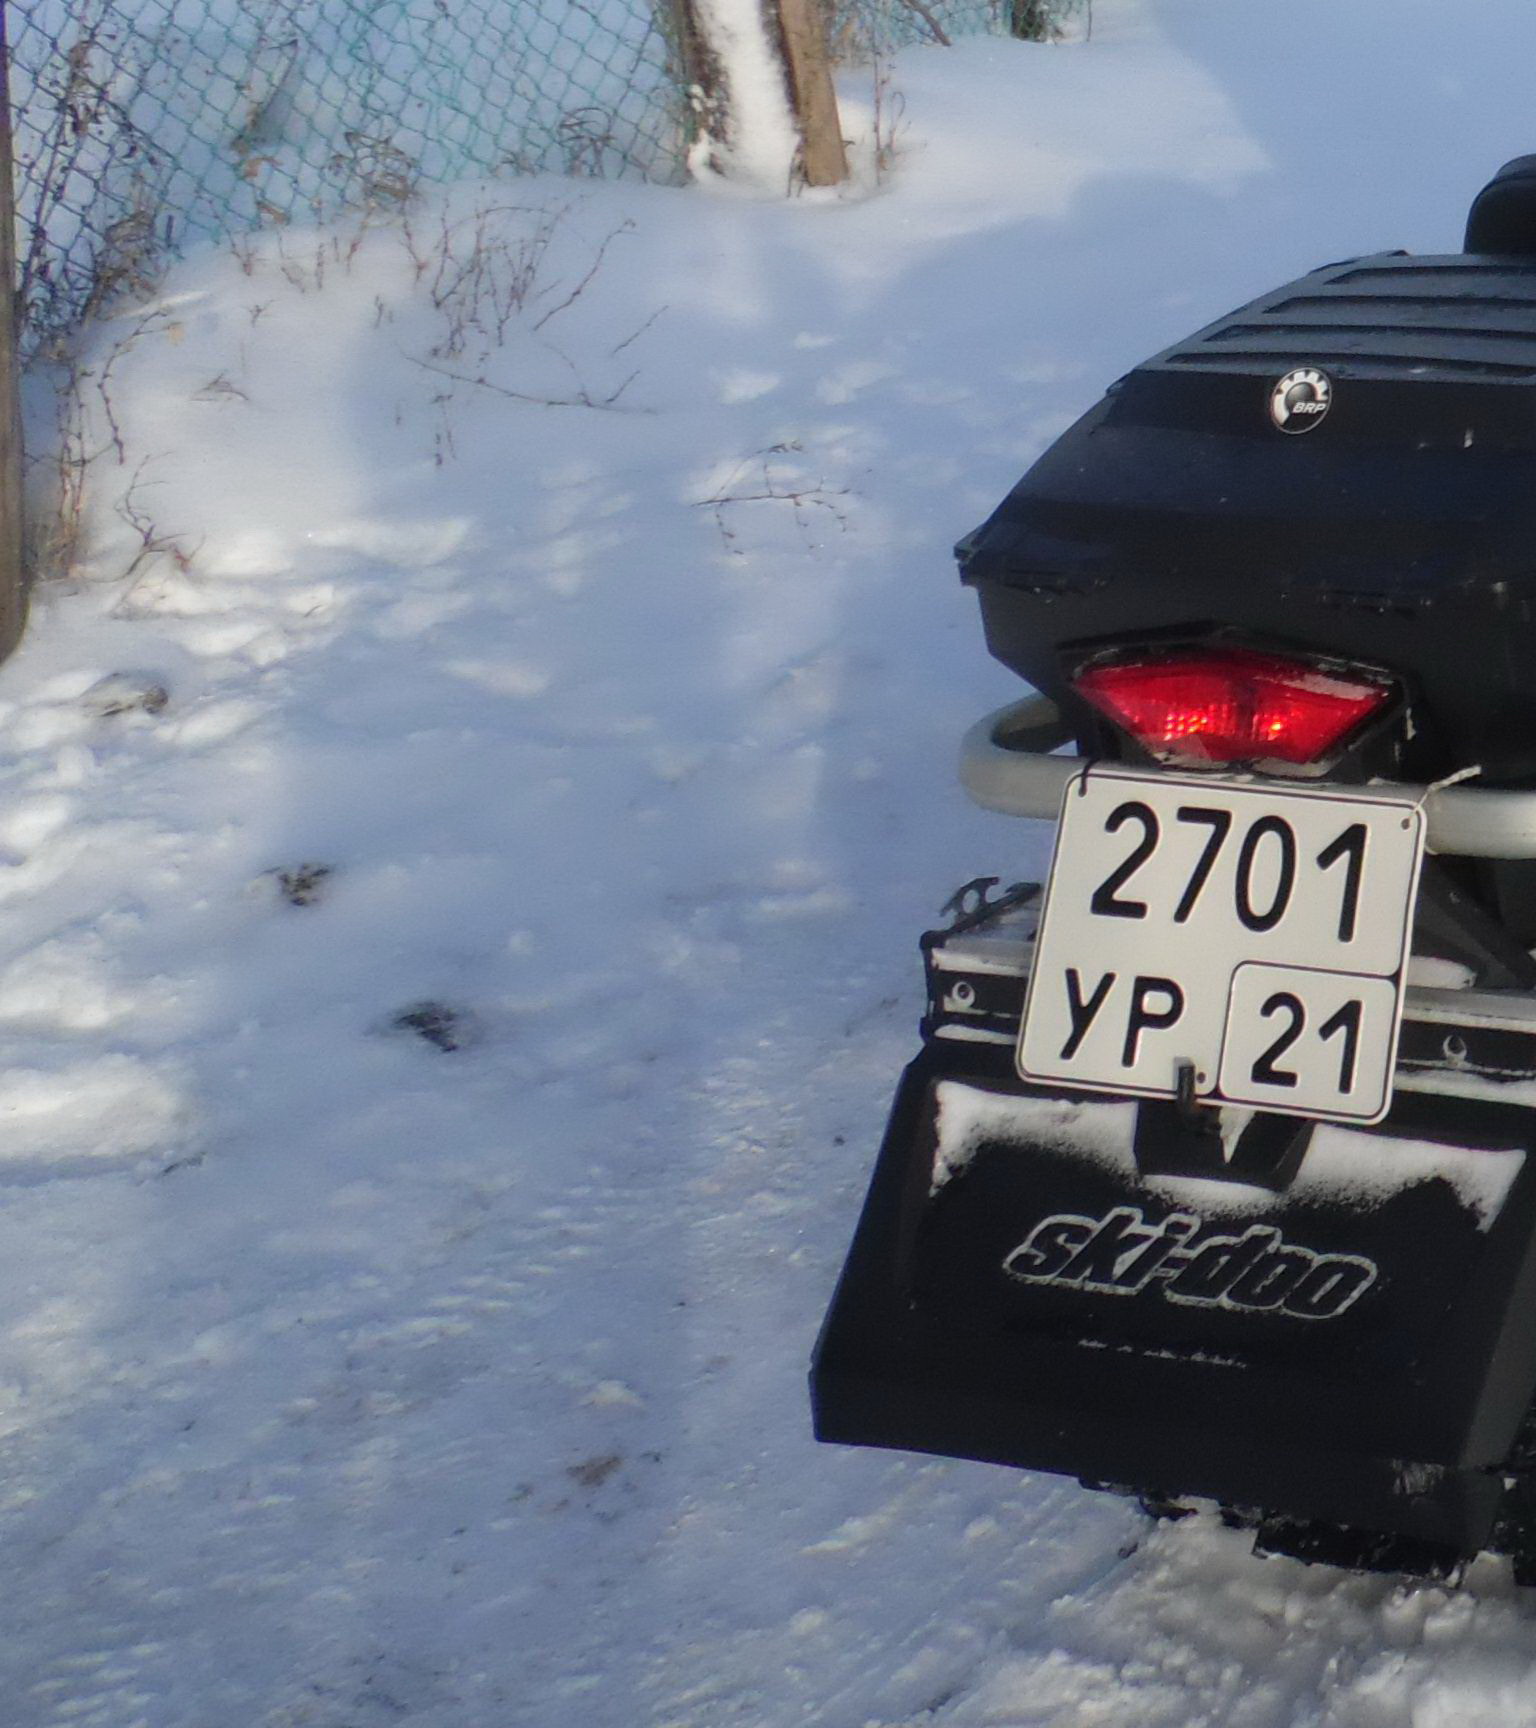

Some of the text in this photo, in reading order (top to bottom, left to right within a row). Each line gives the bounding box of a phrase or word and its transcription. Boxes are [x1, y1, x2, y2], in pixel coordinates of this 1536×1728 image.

[1293, 402, 1326, 414] BRP
[1090, 800, 1369, 944] 2701
[1059, 968, 1364, 1096] УР 21
[1003, 1206, 1378, 1320] ski-doo
